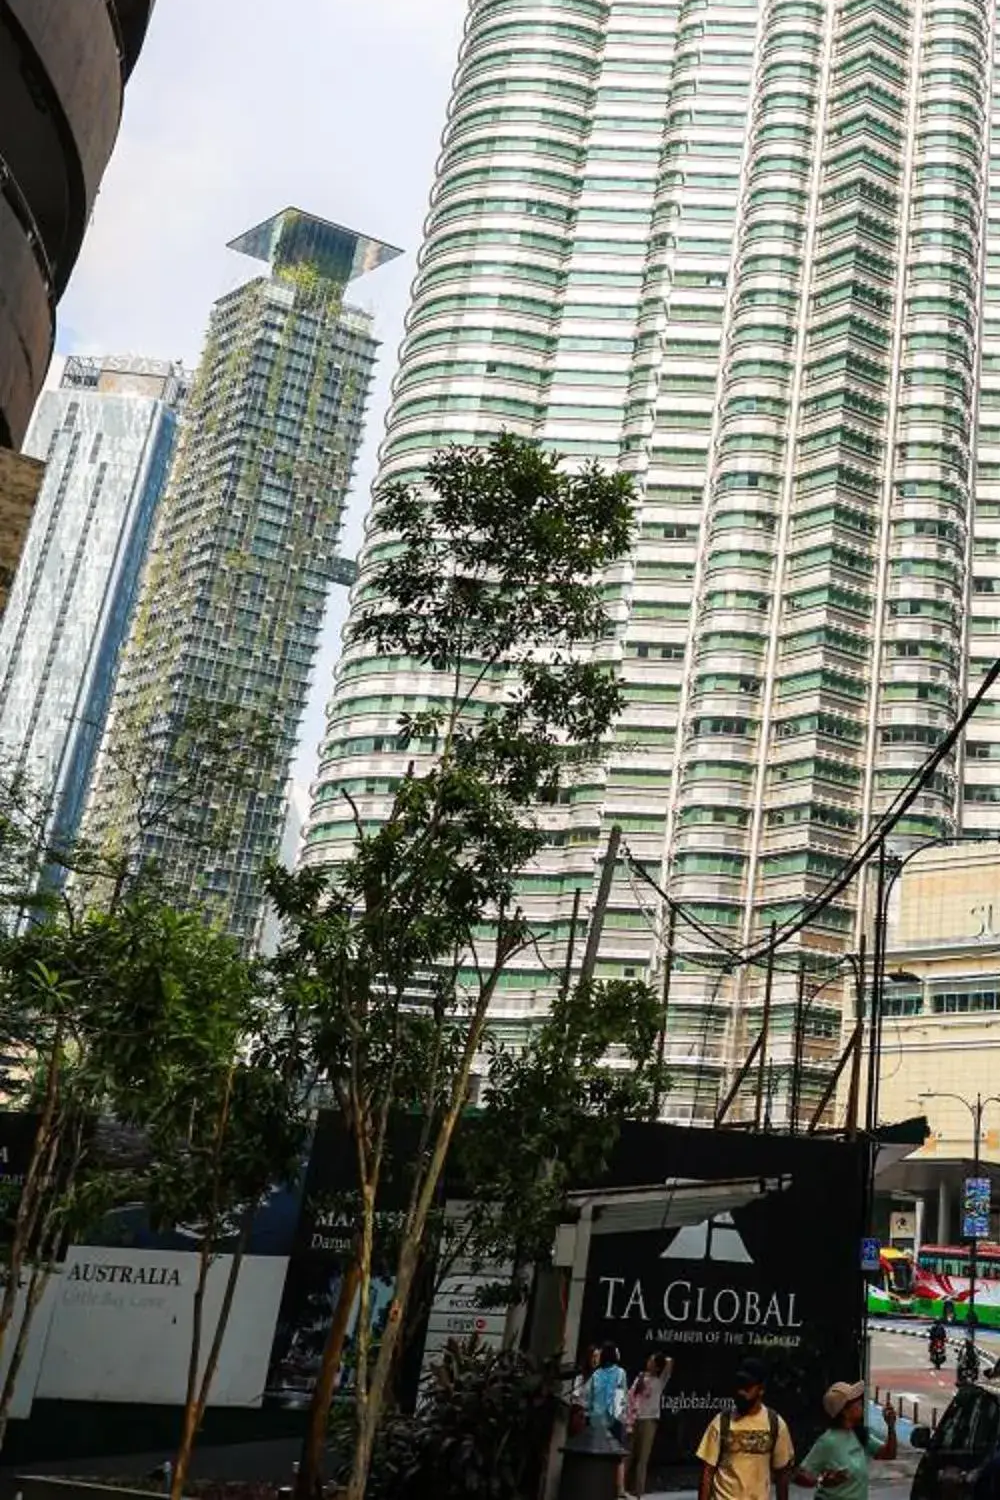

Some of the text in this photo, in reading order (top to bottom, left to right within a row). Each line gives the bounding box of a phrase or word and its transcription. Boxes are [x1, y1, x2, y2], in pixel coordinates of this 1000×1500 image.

[67, 1263, 182, 1286] AUSTRALIA
[599, 1276, 803, 1327] TA GLOBAL
[655, 1329, 703, 1344] MEMBER
[705, 1331, 720, 1343] OF
[724, 1331, 744, 1345] THE
